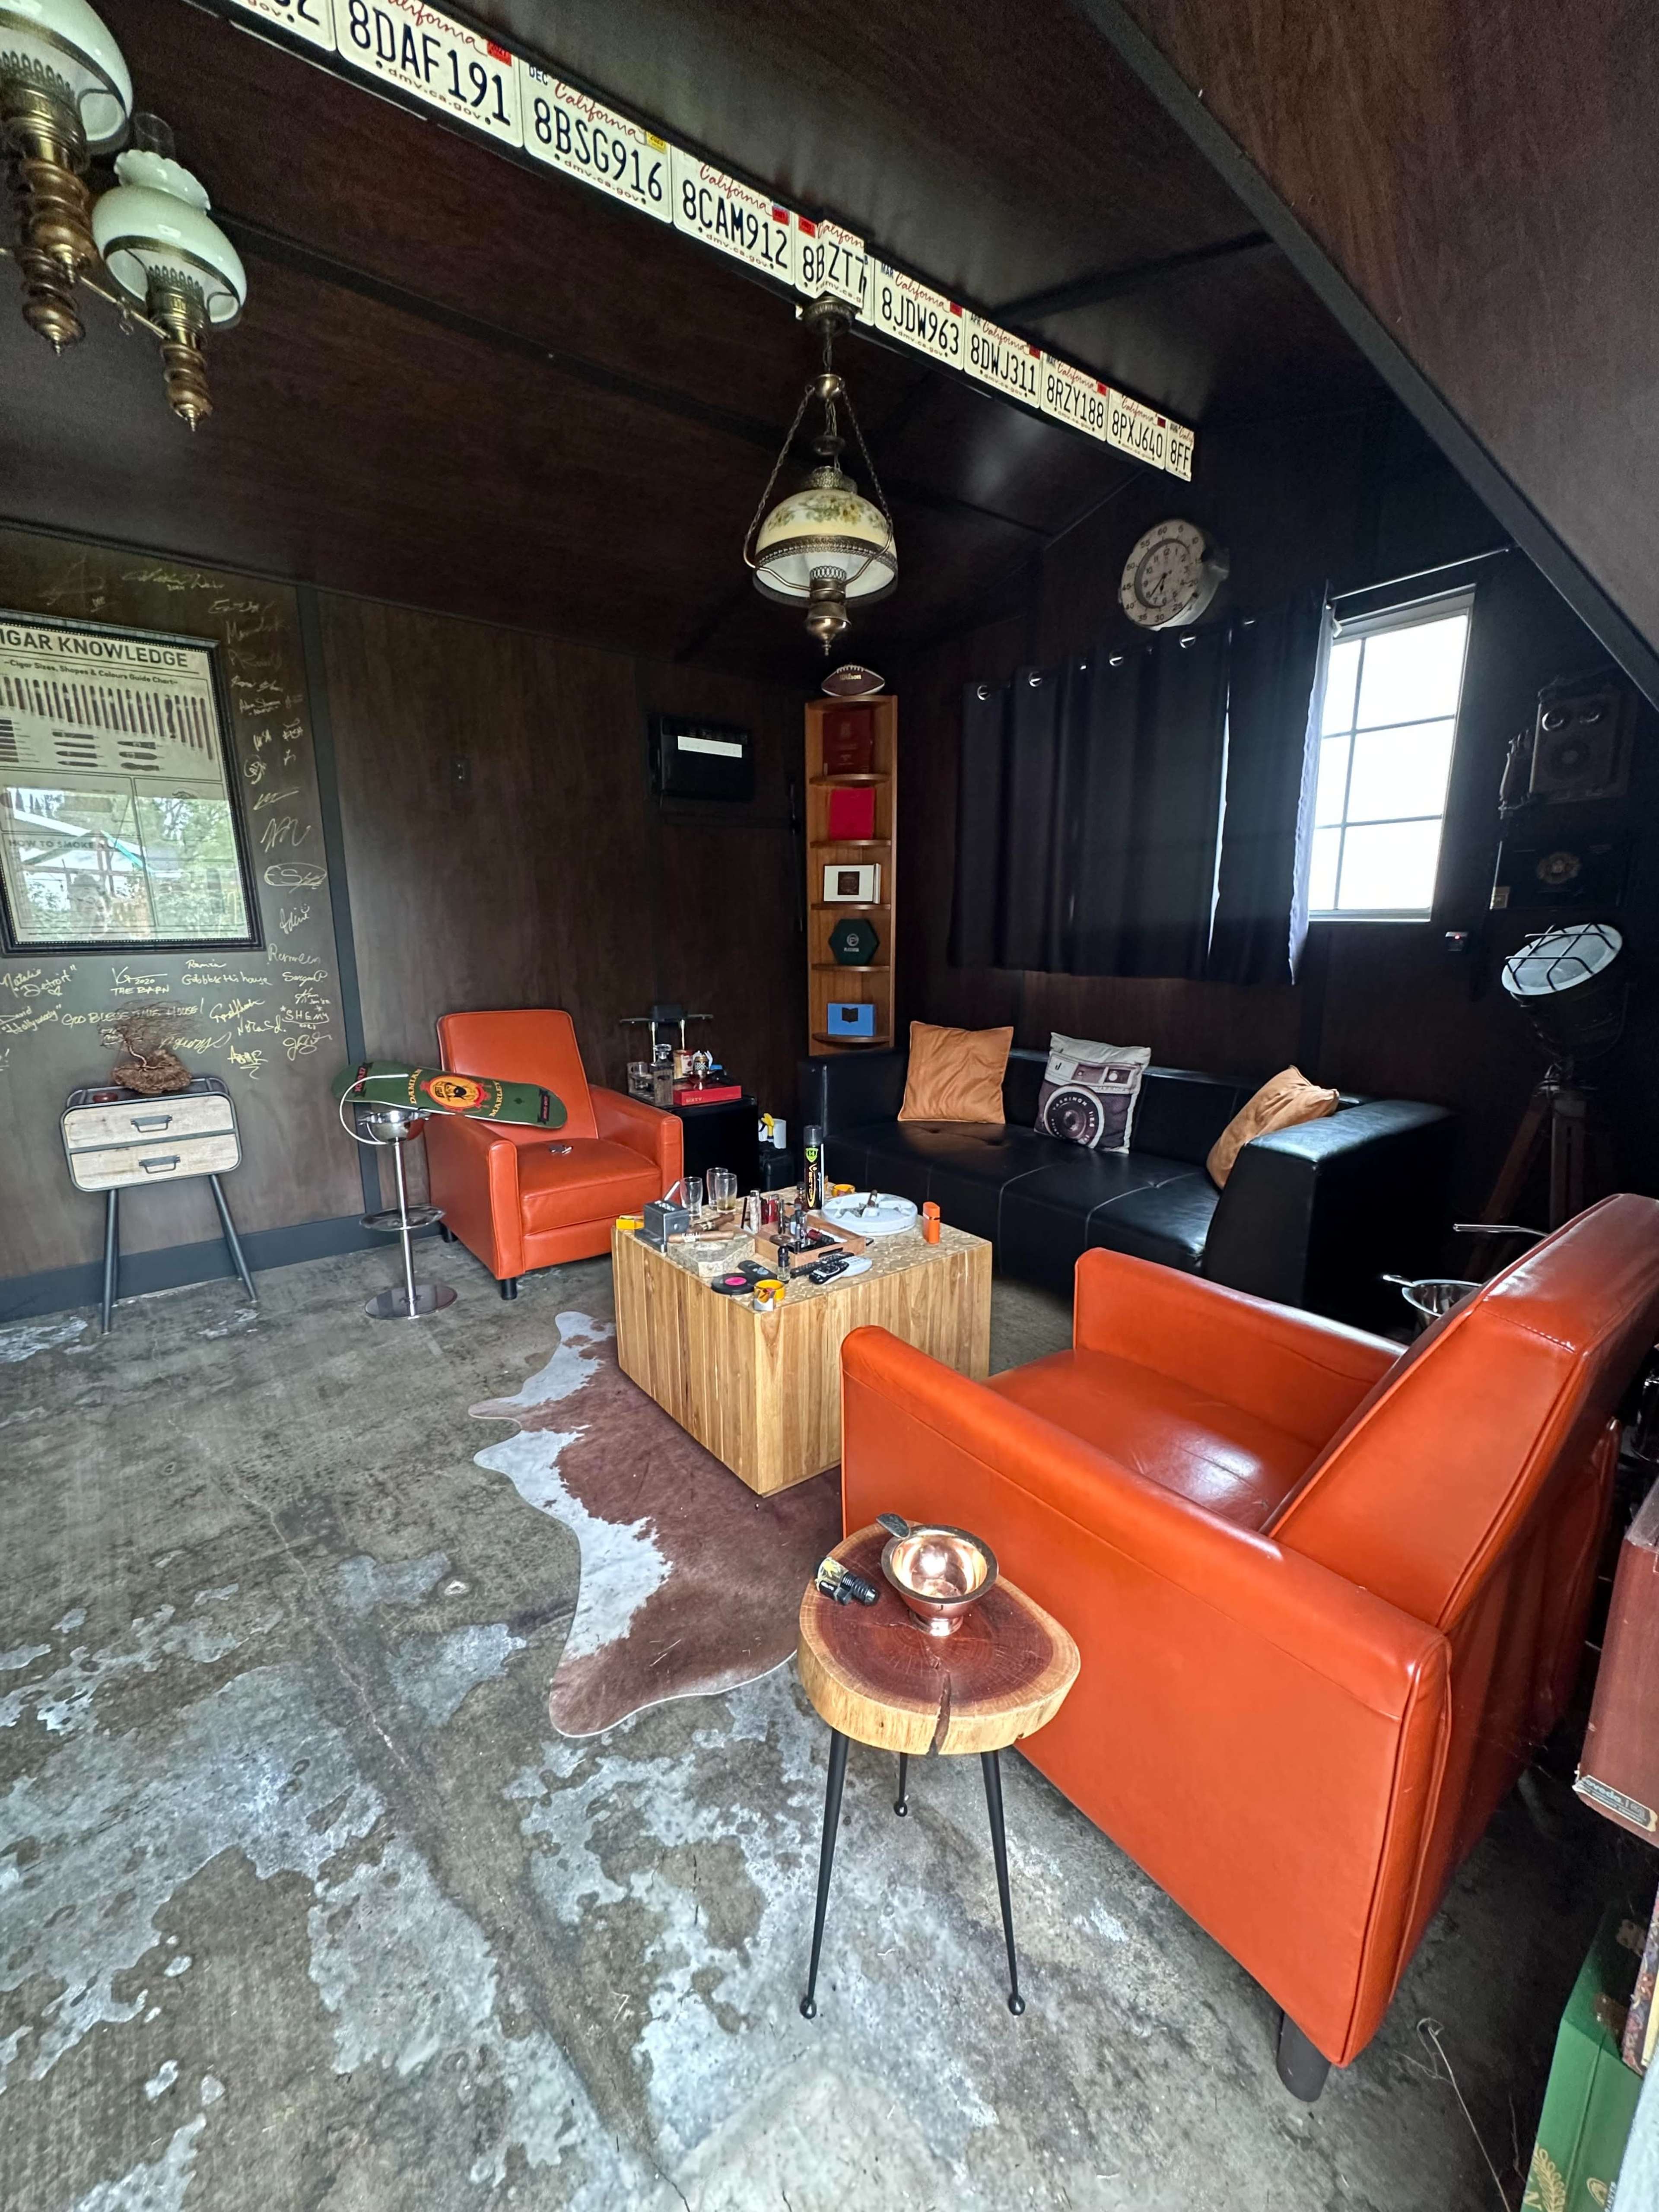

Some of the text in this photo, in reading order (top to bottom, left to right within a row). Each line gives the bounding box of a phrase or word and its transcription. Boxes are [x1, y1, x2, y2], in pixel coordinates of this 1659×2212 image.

[349, 0, 511, 126] 8DAF191
[529, 65, 548, 86] DEC
[388, 68, 481, 120] dmv.ca.gov
[555, 82, 647, 146] California
[534, 98, 662, 202] 8BSG916
[564, 159, 639, 201] dmv.ca.gov
[700, 163, 773, 217] California
[682, 179, 788, 269] 8CAM912
[706, 233, 768, 268] dmv.ca.gov
[881, 263, 894, 279] MAR
[895, 273, 950, 313] California
[881, 287, 959, 355] 8JDW963
[982, 321, 1031, 356] California
[898, 330, 943, 356] dmv.ca.gov
[970, 334, 1036, 396] 8DWJ311
[1057, 361, 1097, 394] California
[984, 372, 1023, 396] dmv.ca.gov
[1046, 375, 1104, 429] 8RZY188
[1122, 396, 1157, 426] California
[1112, 410, 1163, 459] 8PXJ640
[1170, 439, 1191, 470] 8FF
[58, 636, 188, 668] KNOWLEDGE
[60, 666, 88, 675] Shapes
[98, 671, 128, 680] Colours
[129, 673, 151, 683] Guide
[110, 985, 170, 996] THE BARN
[408, 1068, 423, 1105] DAMIAN
[489, 1080, 503, 1117] MARLEY
[1585, 1778, 1624, 1805] oveda
